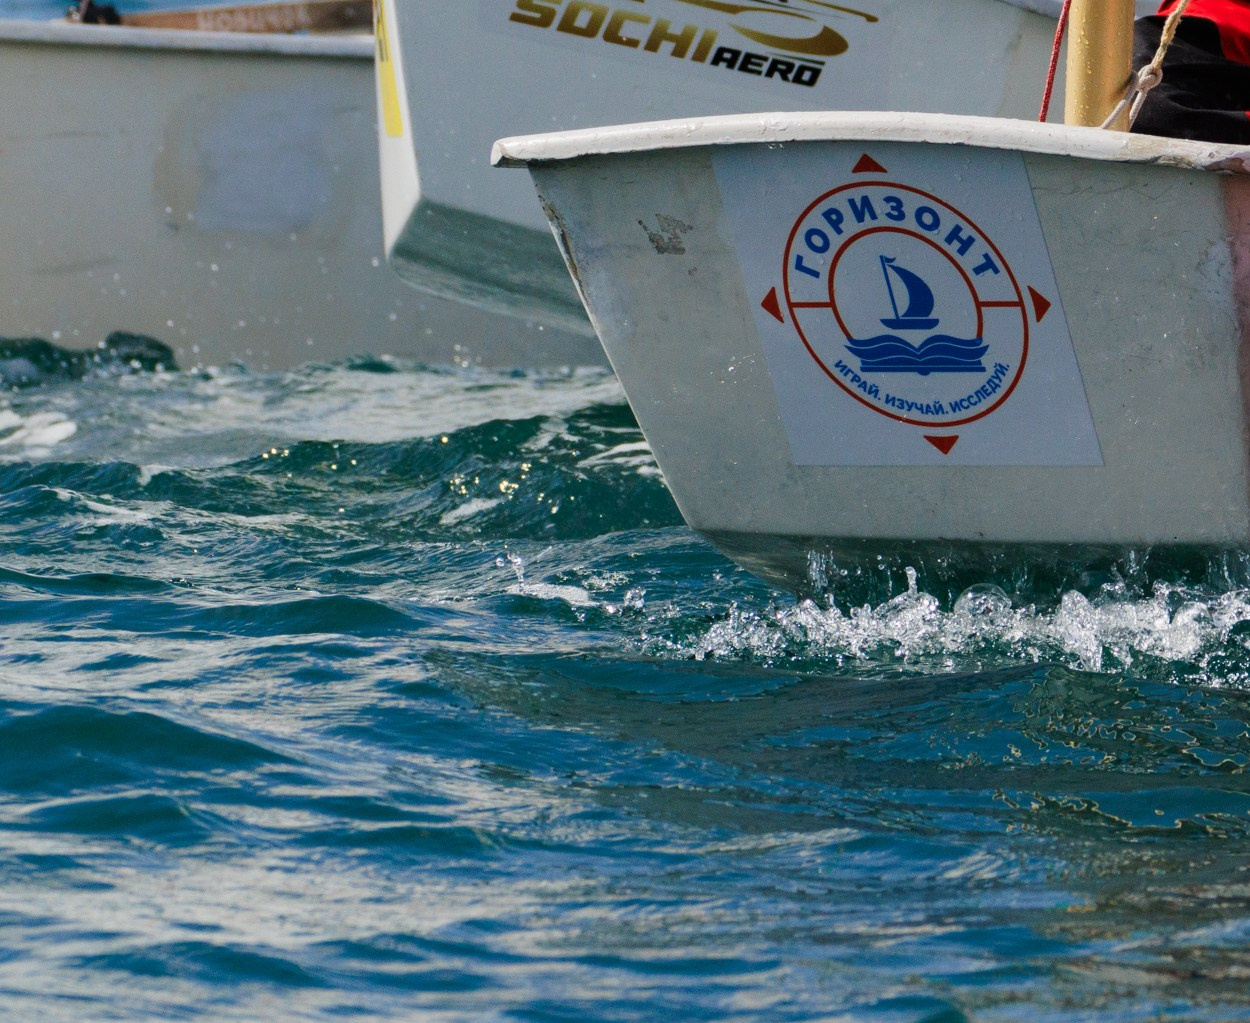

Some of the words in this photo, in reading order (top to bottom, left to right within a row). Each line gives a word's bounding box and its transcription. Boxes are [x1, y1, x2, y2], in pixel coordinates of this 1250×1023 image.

[710, 47, 822, 88] AERO
[795, 195, 1000, 279] ГОРИЗОНТ
[834, 360, 881, 401] ИГРАЙ.
[885, 394, 949, 416] ИЗУЧАЙ.
[950, 362, 1011, 414] ИССЛЕДУЙ.
